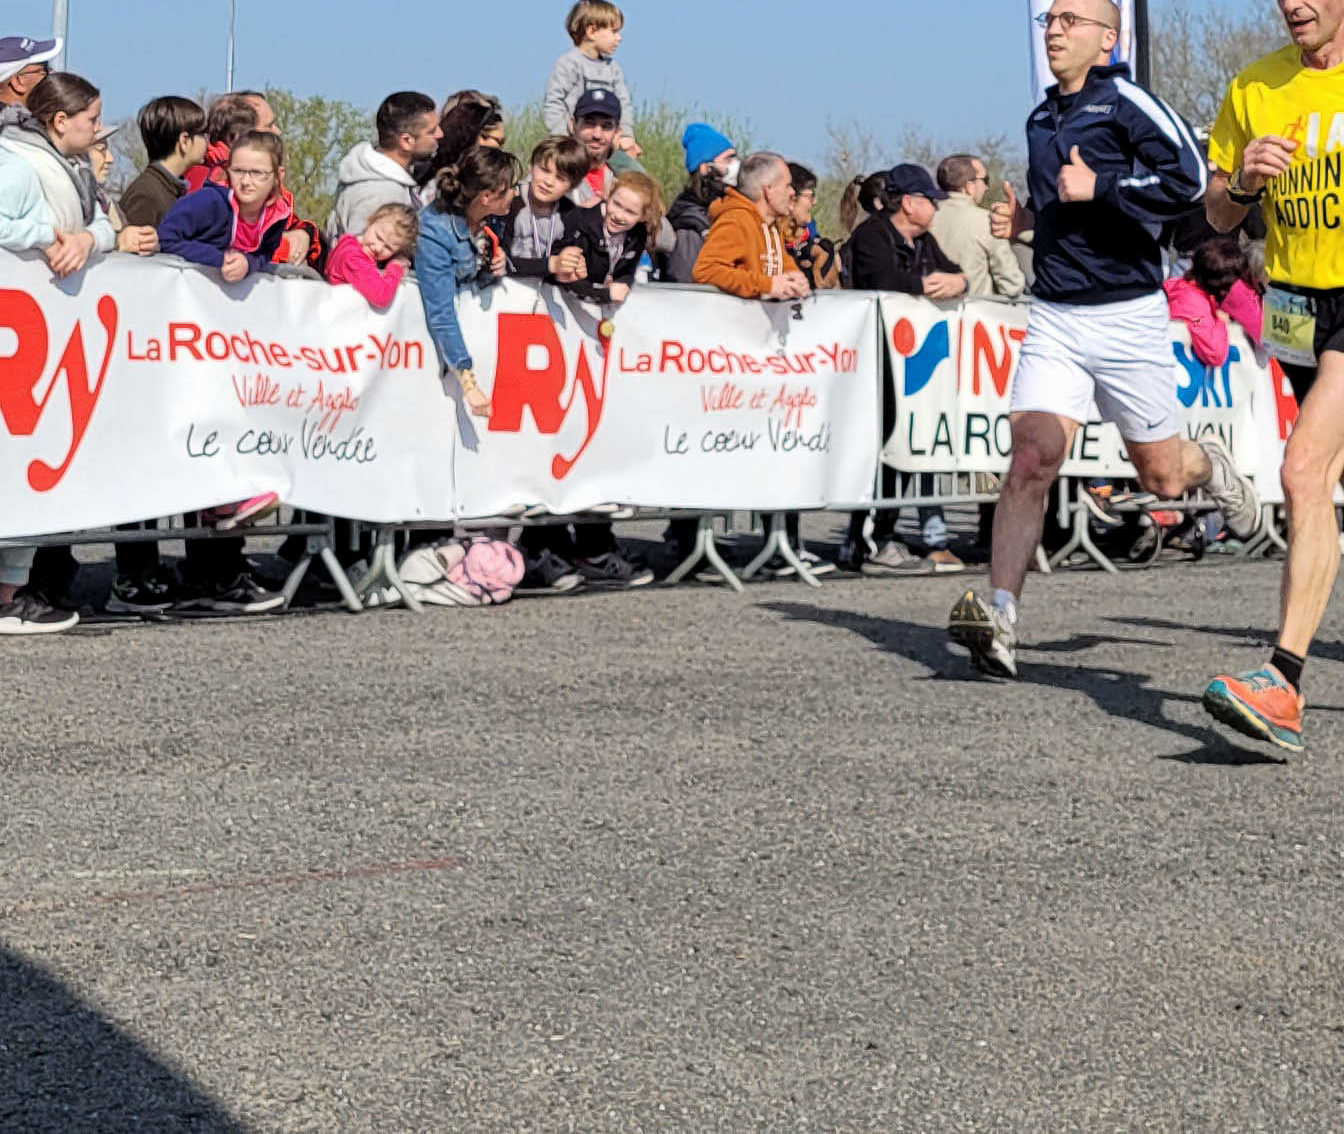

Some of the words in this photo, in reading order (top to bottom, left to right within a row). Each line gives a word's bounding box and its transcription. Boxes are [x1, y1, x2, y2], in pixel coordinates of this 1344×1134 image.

[1306, 112, 1321, 158] I
[127, 329, 161, 362] La
[167, 321, 424, 373] Roche-sur-Yon
[619, 346, 652, 373] La
[231, 373, 281, 409] Ville
[285, 380, 308, 410] et
[306, 379, 361, 434] Agglo
[488, 312, 612, 481] Ry
[700, 382, 745, 413] Ville
[749, 389, 771, 411] et
[186, 422, 220, 459] Le
[301, 417, 378, 464] Vendée
[664, 424, 689, 455] Le
[908, 411, 953, 456] LA
